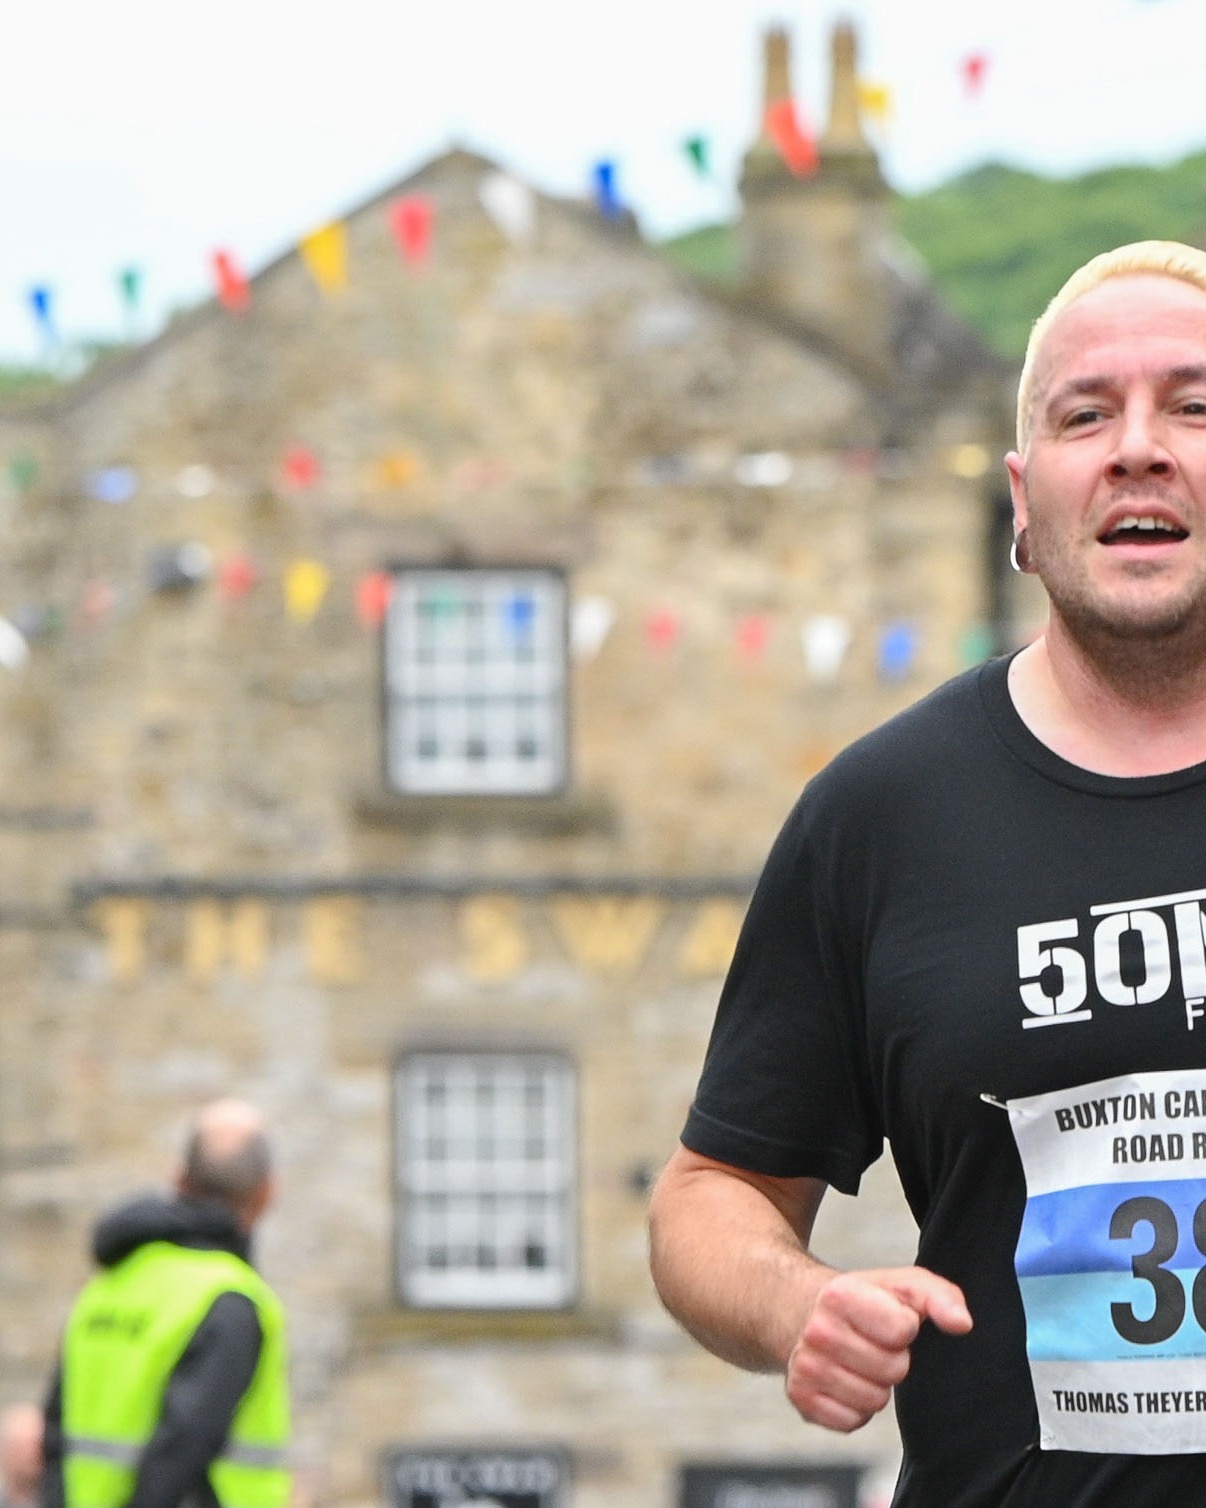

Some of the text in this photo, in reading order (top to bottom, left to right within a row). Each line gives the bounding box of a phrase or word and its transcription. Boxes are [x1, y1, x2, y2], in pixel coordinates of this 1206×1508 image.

[90, 895, 366, 984] THE
[1054, 1091, 1157, 1133] BUXTON
[1112, 1132, 1184, 1165] ROAD
[1052, 1389, 1130, 1414] THOMAS
